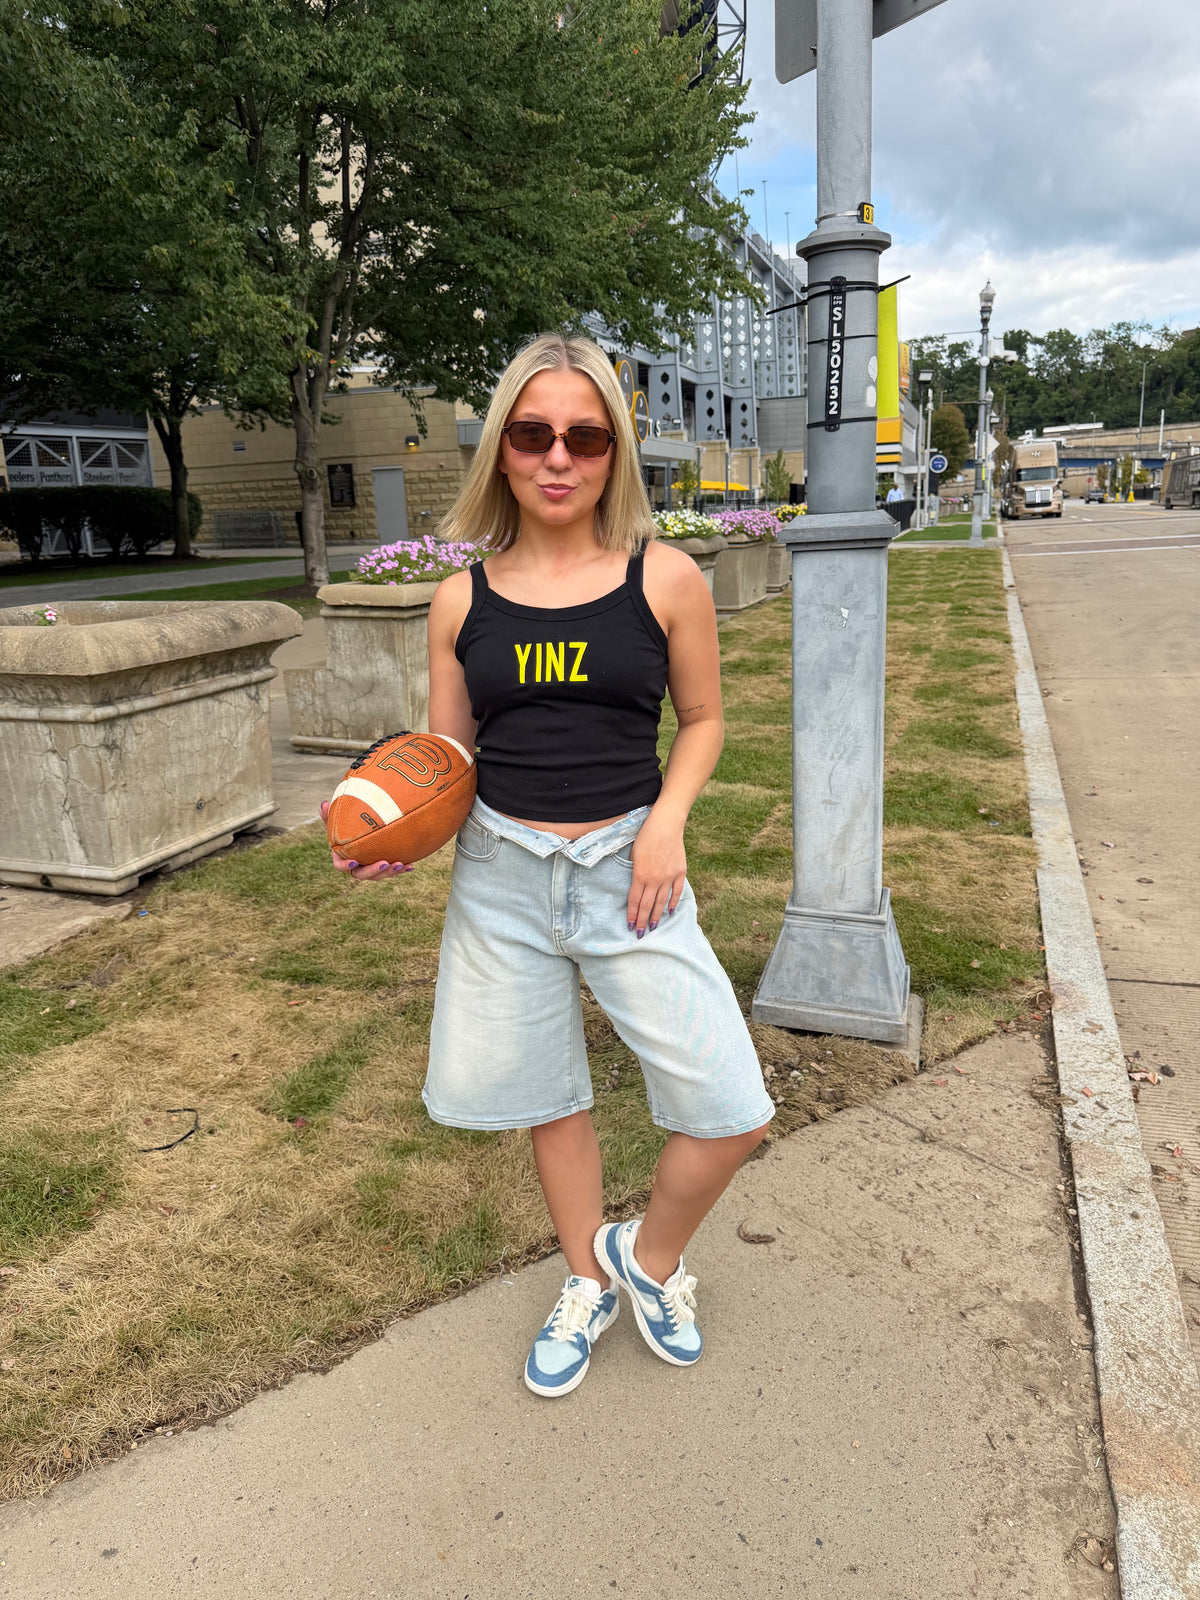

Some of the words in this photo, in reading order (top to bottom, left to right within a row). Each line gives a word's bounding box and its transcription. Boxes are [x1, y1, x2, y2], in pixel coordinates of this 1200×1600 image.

[828, 306, 843, 415] SL50232
[9, 471, 35, 482] eelers
[40, 471, 73, 482] Panthers
[83, 472, 114, 482] Steelers
[514, 641, 589, 684] YINZ
